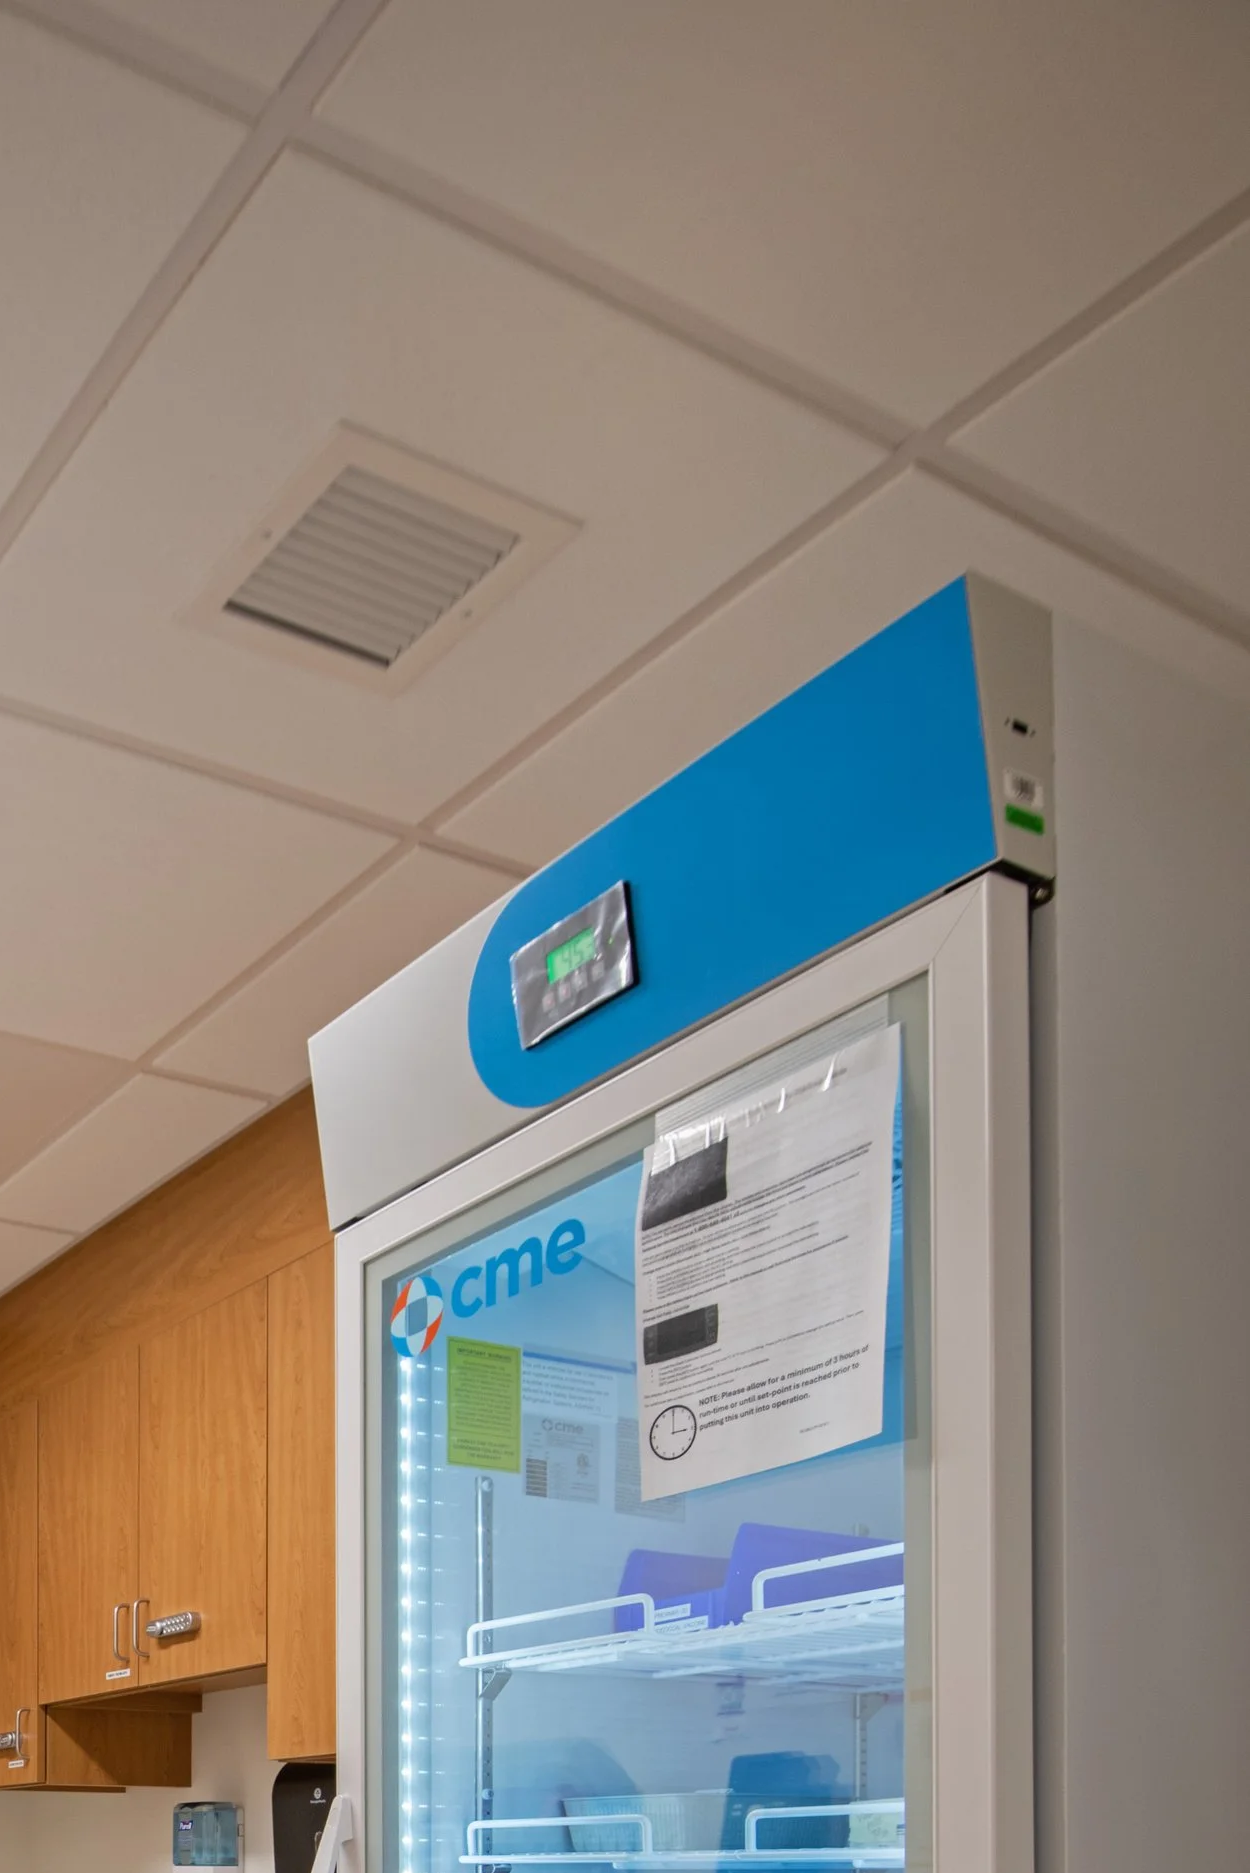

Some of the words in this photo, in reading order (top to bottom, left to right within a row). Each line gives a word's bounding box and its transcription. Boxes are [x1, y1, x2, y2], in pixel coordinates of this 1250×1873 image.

[451, 1218, 586, 1319] cme
[699, 1394, 721, 1406] NOTE:
[721, 1387, 745, 1399] Please
[746, 1380, 766, 1391] allow
[768, 1375, 779, 1385] for
[787, 1362, 823, 1379] minimum
[825, 1358, 832, 1367] of
[833, 1356, 838, 1364] 3
[839, 1348, 860, 1361] hours
[862, 1343, 870, 1353] of
[699, 1404, 729, 1418] run-time
[739, 1395, 756, 1406] until
[757, 1385, 792, 1400] set-point
[793, 1382, 800, 1390] is
[801, 1371, 832, 1387] reached
[833, 1366, 851, 1378] prior
[555, 1420, 584, 1435] cme
[699, 1417, 724, 1431] putting
[724, 1413, 739, 1423] this
[740, 1408, 754, 1418] unit
[755, 1404, 769, 1413] into
[771, 1392, 810, 1409] operation.
